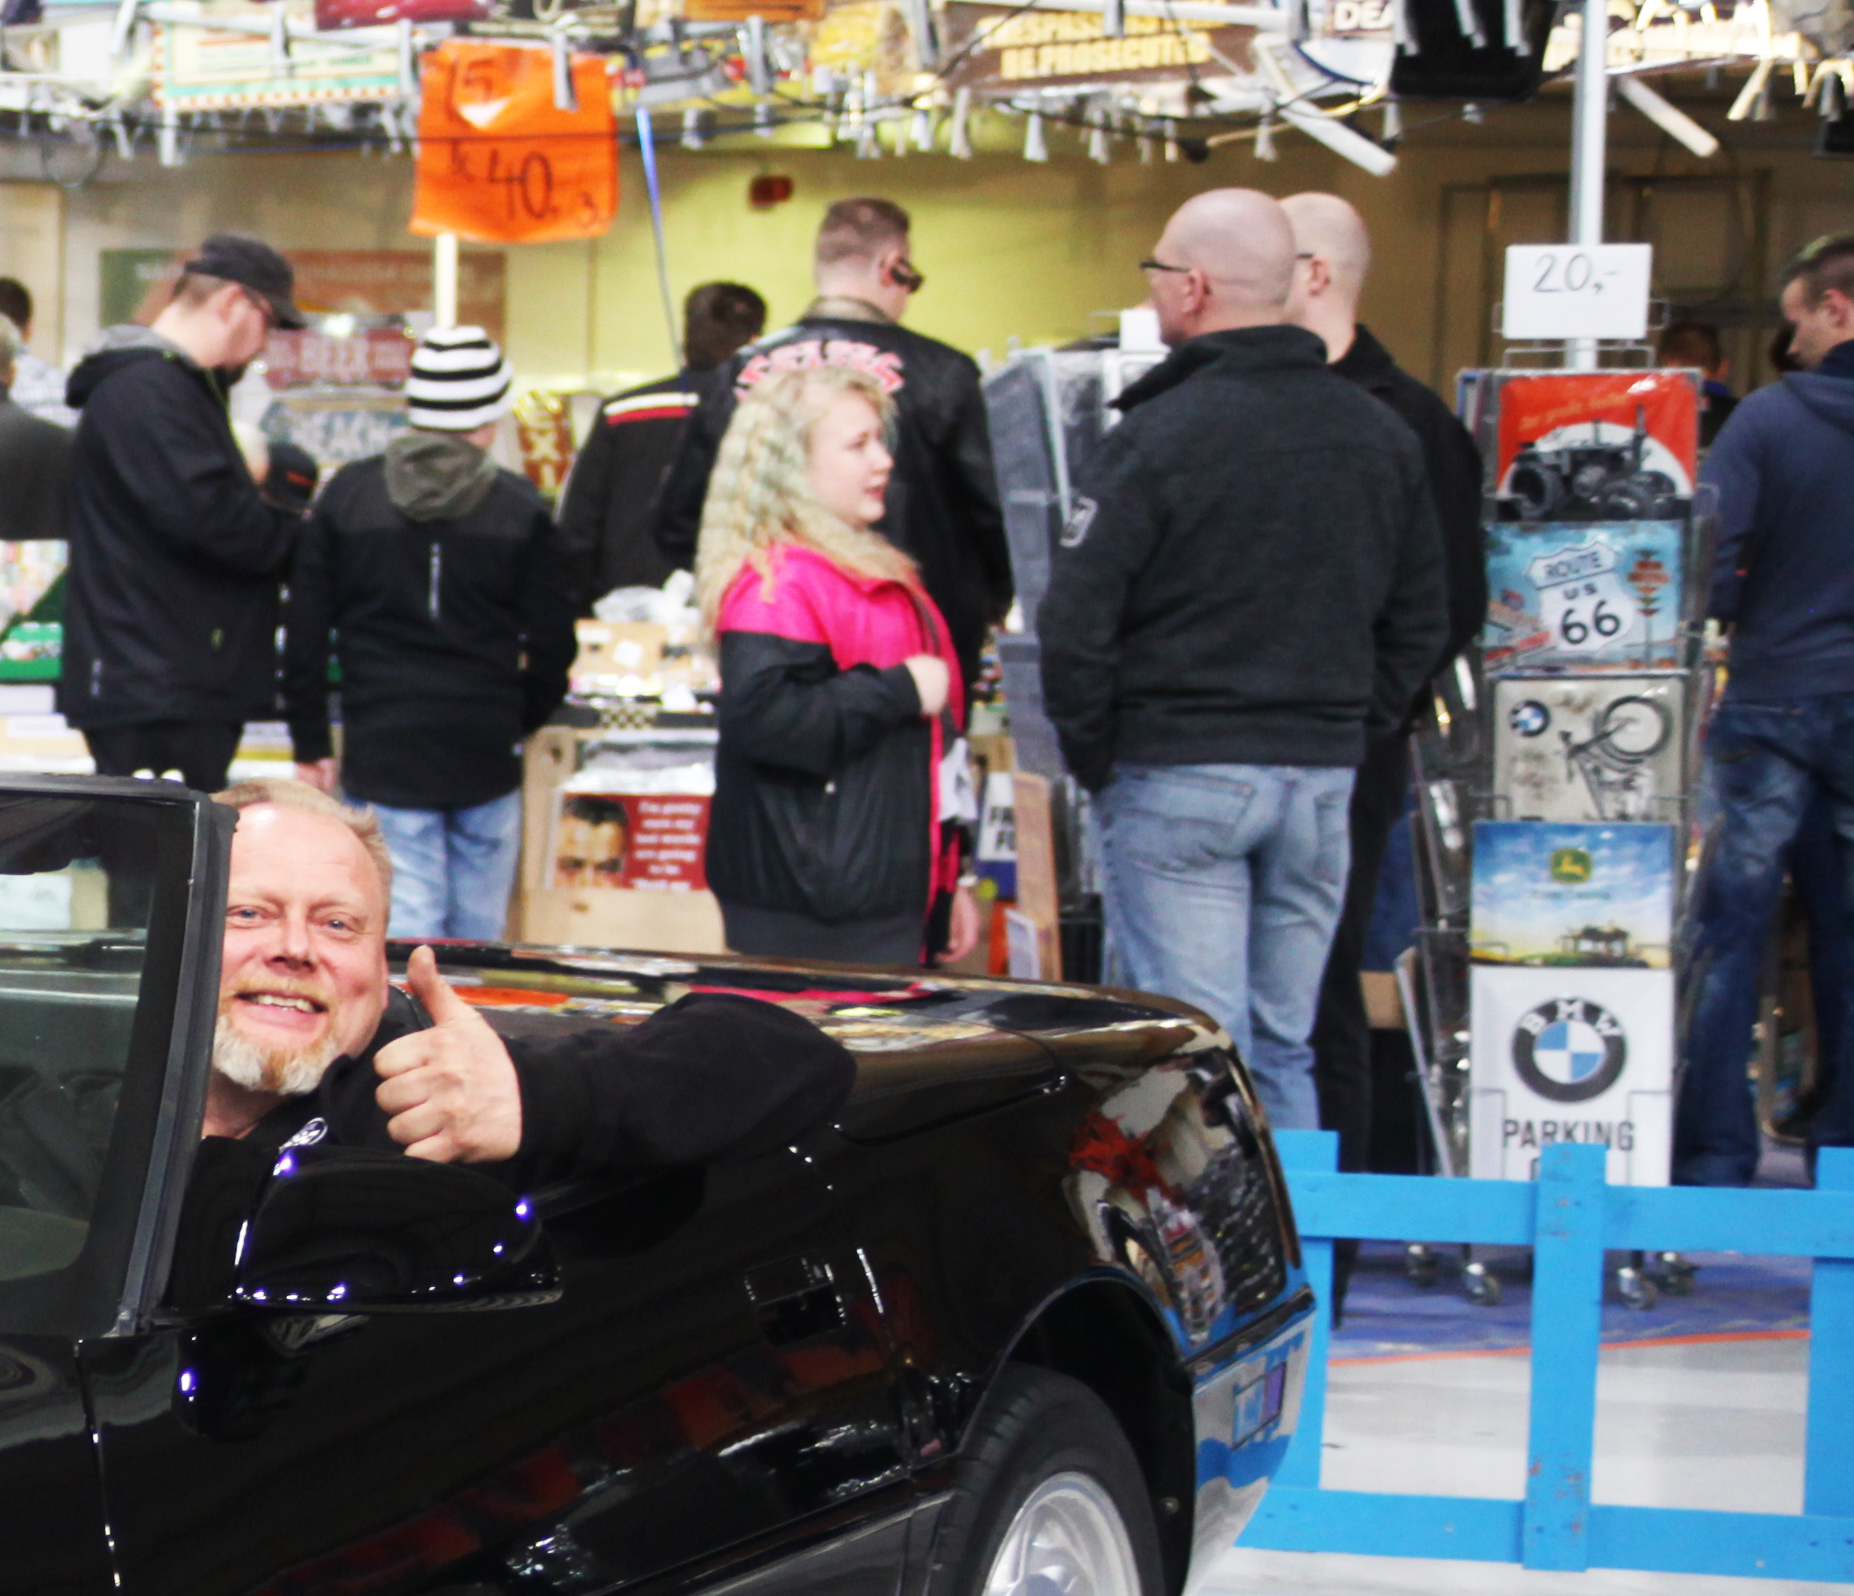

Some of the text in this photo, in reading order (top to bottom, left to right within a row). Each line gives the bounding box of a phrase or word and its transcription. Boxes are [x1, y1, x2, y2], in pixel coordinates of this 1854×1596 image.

[1544, 552, 1603, 577] ROUTE
[1561, 600, 1622, 645] 66
[1520, 1000, 1625, 1037] BMW
[1504, 1119, 1635, 1150] PARKING
